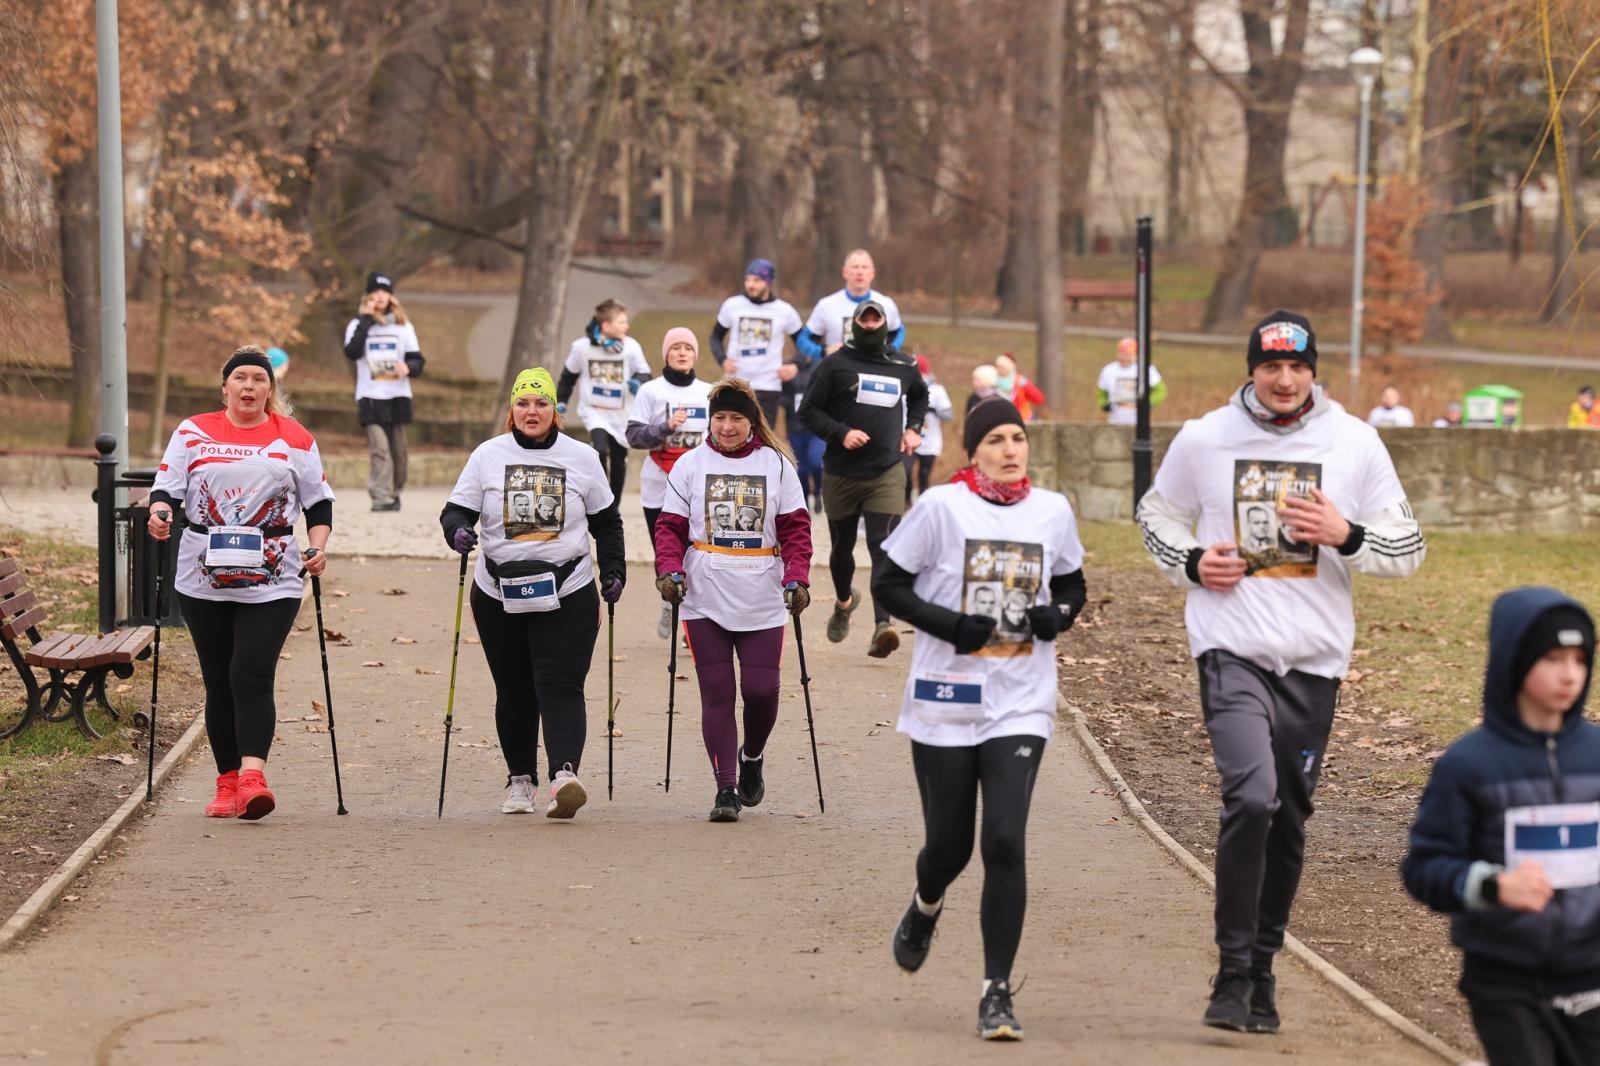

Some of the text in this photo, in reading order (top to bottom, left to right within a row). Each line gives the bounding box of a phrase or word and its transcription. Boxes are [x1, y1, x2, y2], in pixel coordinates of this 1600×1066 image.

[200, 446, 253, 457] POLAND
[228, 535, 241, 546] 41
[732, 540, 746, 549] 85
[521, 585, 535, 596] 86
[935, 684, 955, 699] 25
[1558, 826, 1570, 848] 1
